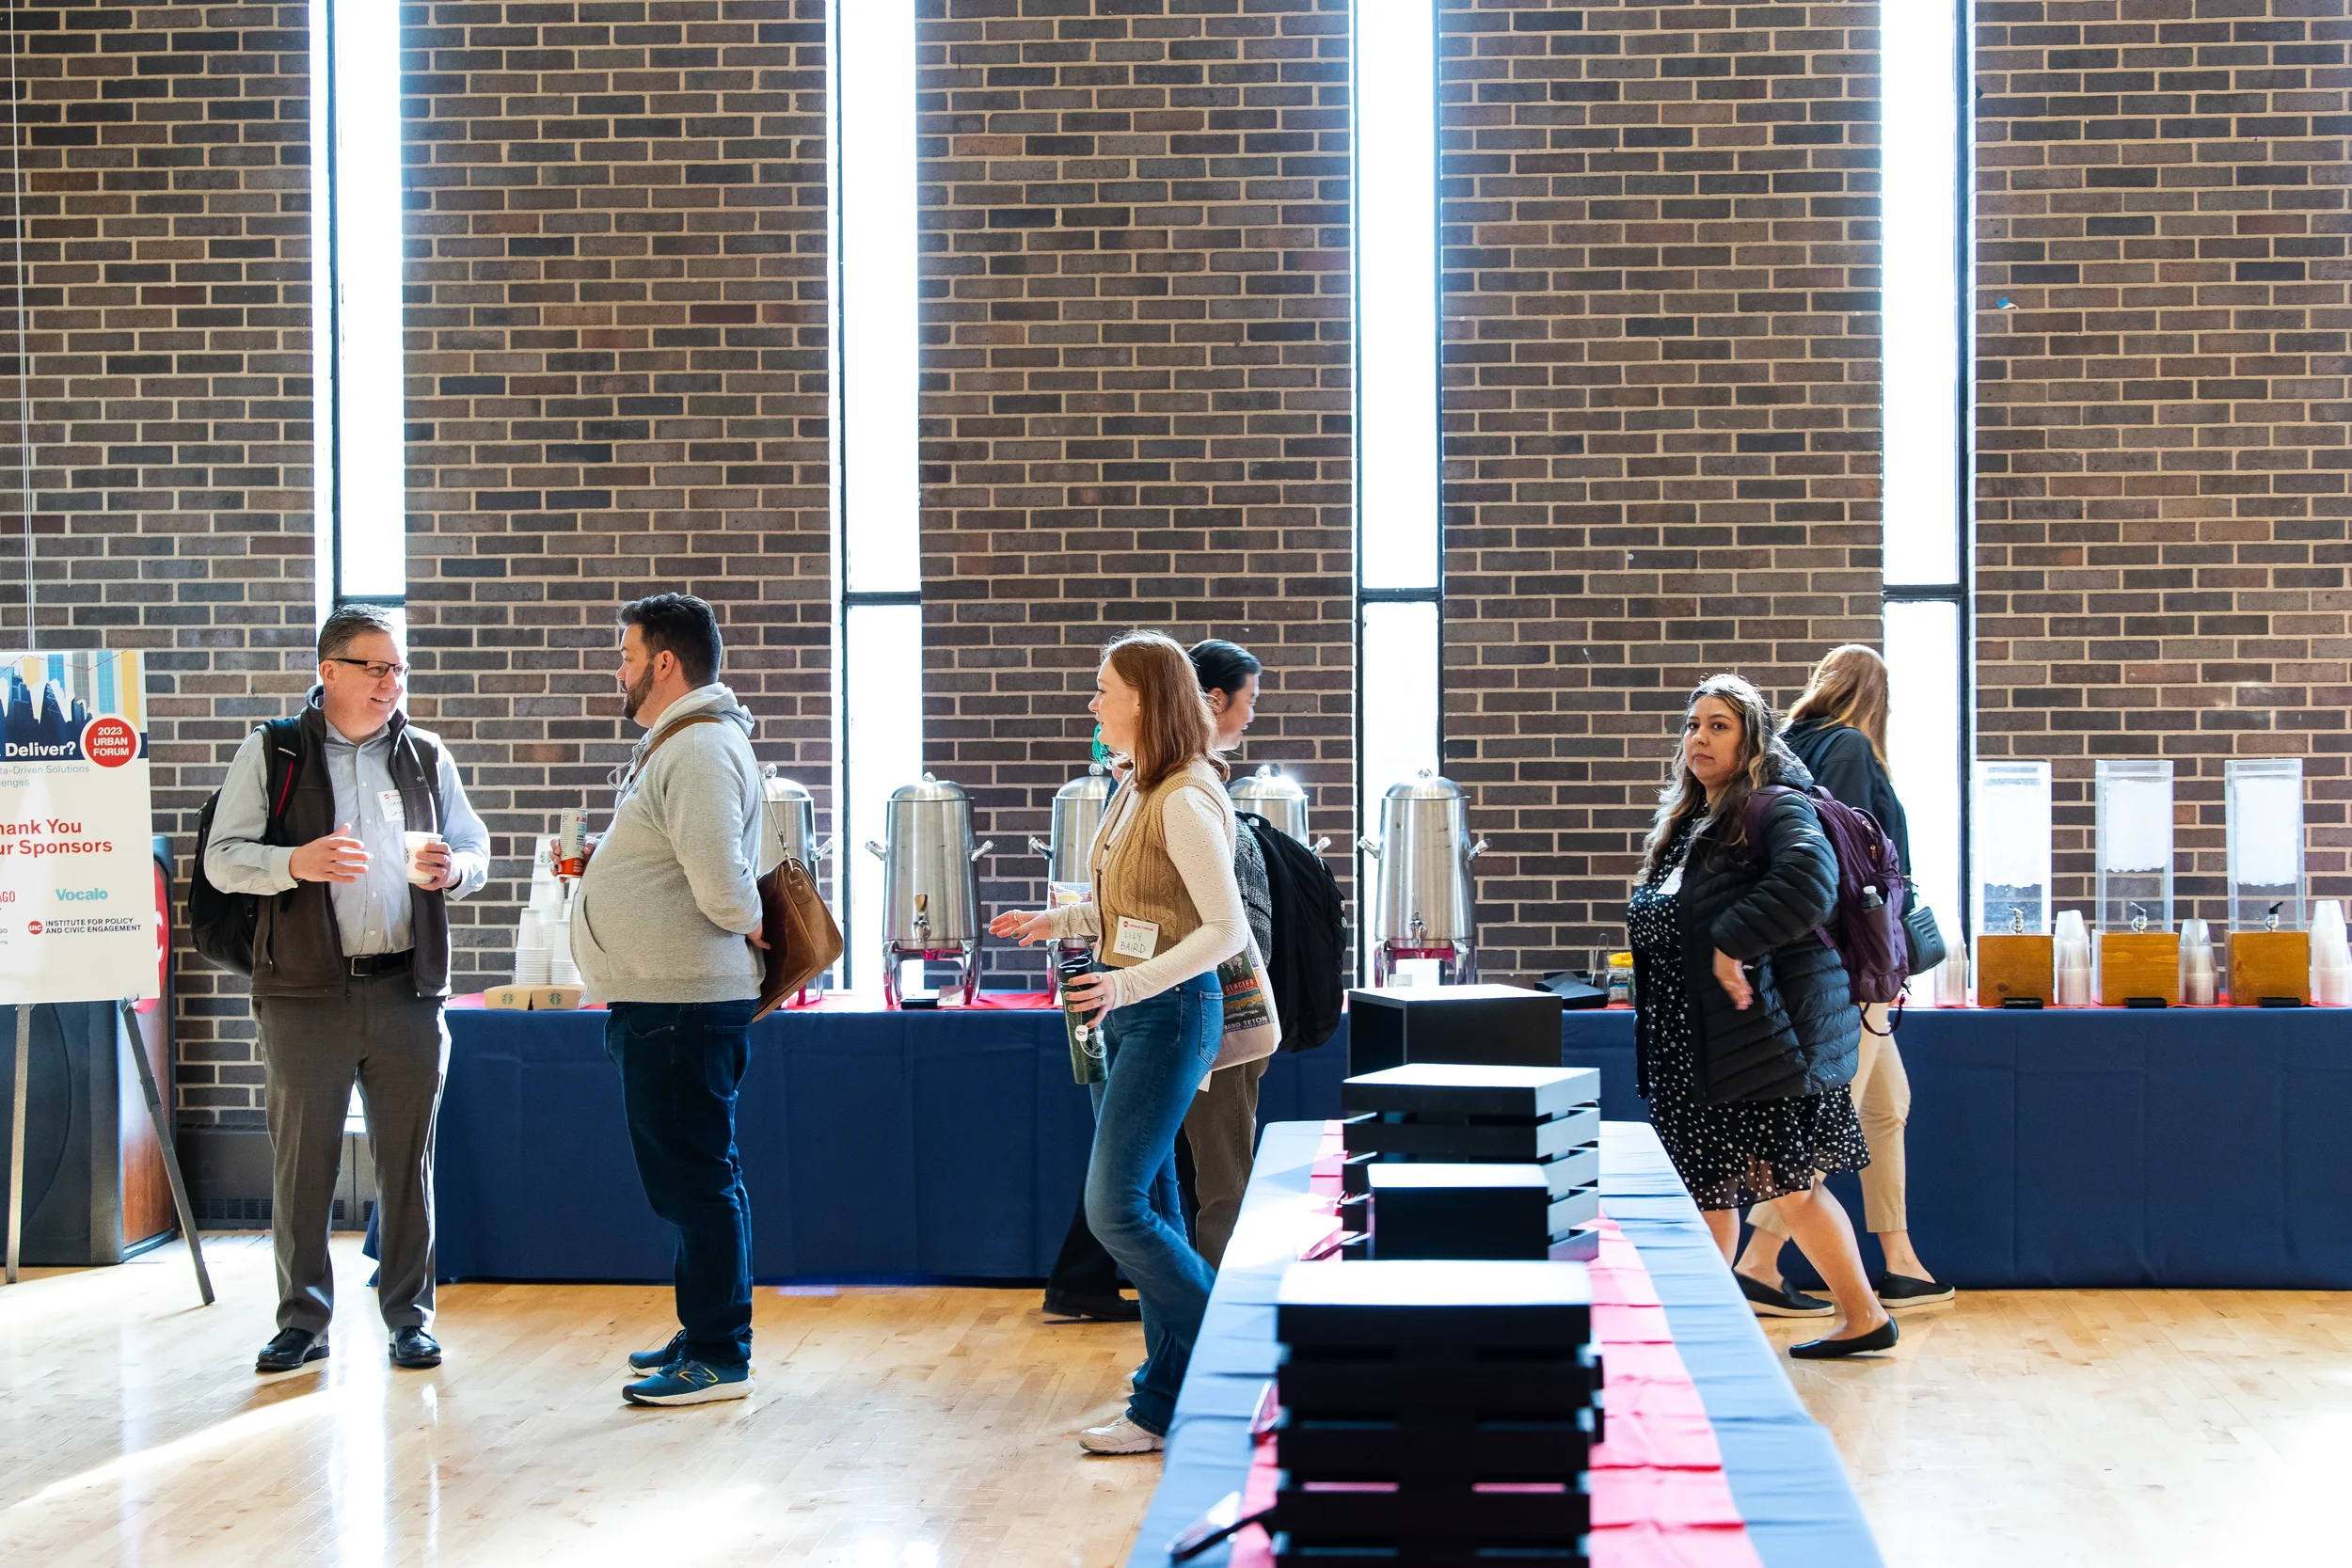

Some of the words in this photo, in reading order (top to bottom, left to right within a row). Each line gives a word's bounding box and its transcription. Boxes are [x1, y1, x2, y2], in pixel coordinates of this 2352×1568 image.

[97, 726, 123, 736] 2023
[93, 736, 128, 746] URBAN
[5, 741, 77, 757] Deliver?
[93, 747, 130, 756] FORUM
[45, 765, 90, 774] Solutions
[46, 818, 82, 834] You
[19, 839, 113, 858] Sponsors
[55, 887, 109, 902] Vocalo
[87, 925, 141, 933] ENGAGEMENT
[1120, 942, 1146, 954] BAIRD
[1225, 978, 1255, 992] GLACIER
[1243, 1016, 1267, 1026] TETON
